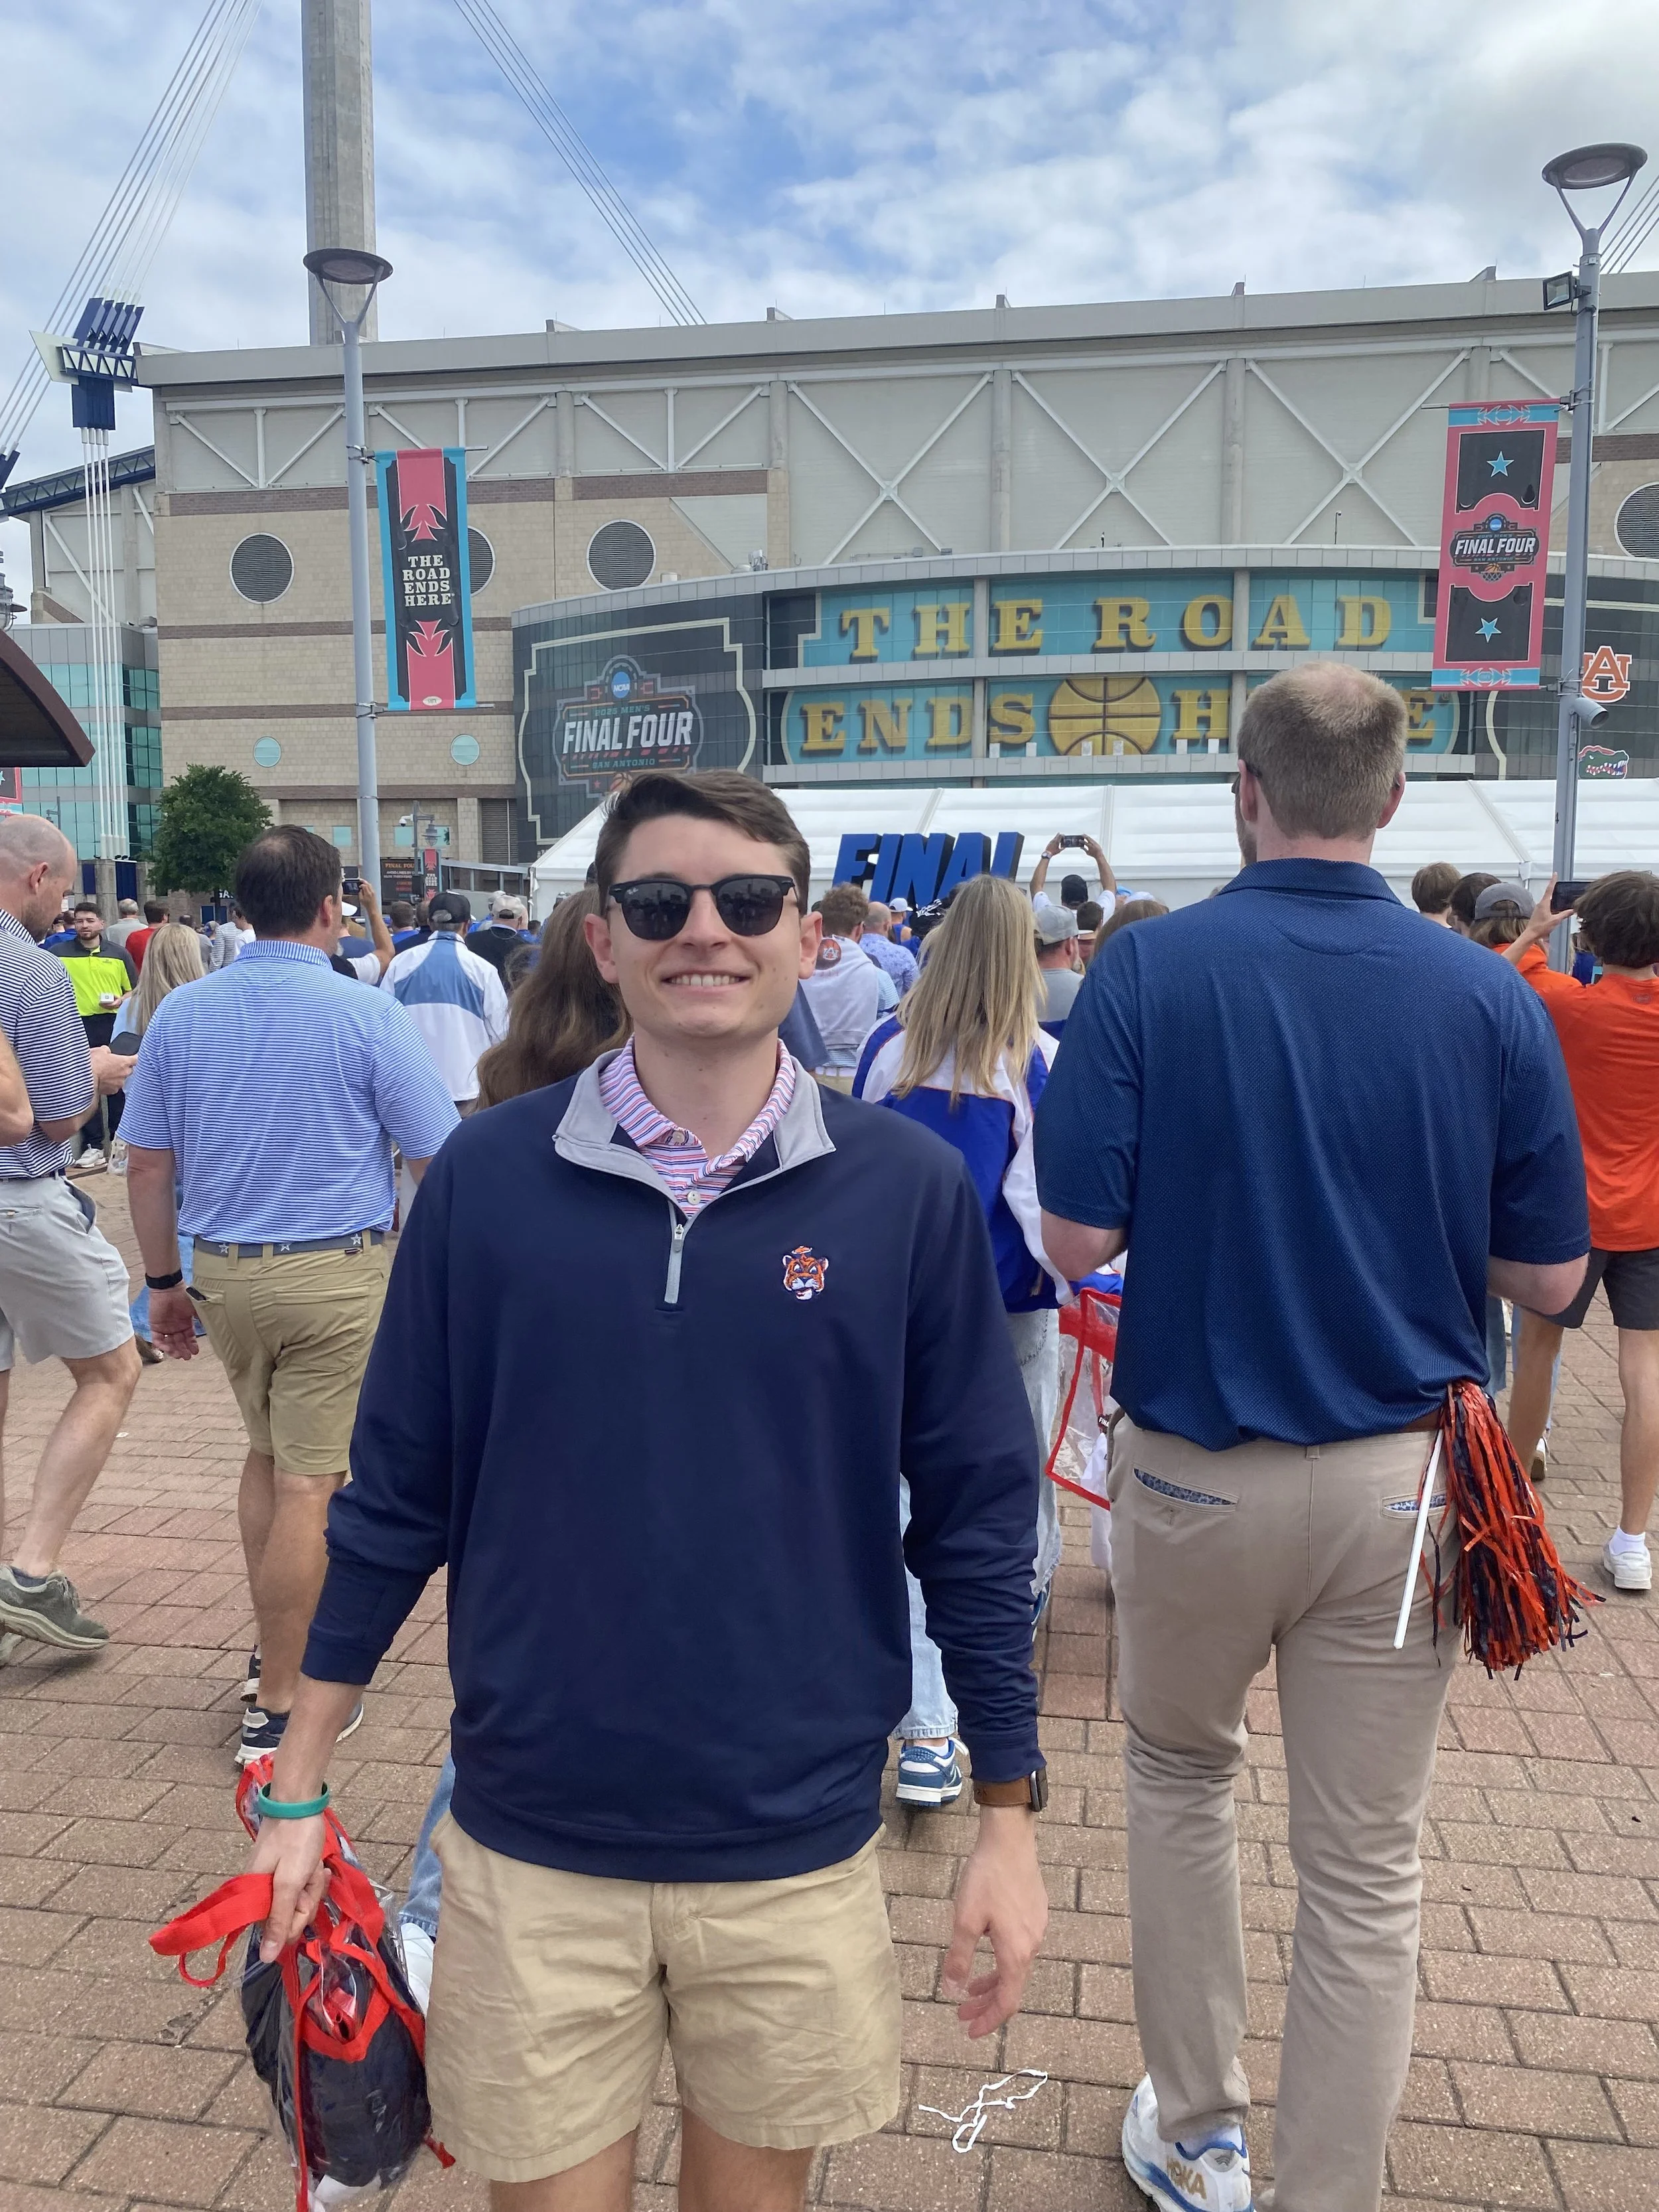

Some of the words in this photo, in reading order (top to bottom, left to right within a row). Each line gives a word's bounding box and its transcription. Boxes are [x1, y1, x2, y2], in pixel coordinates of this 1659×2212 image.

[1455, 539, 1494, 555] FINAL
[1496, 537, 1536, 553] FOUR
[407, 555, 443, 567] THE
[402, 567, 451, 581] ROAD
[403, 580, 450, 594] ENDS
[840, 598, 1043, 658] THE
[1092, 594, 1392, 650] ROAD
[595, 706, 617, 716] 2025
[620, 704, 650, 714] MEN'S
[802, 692, 1036, 751] ENDS
[1173, 688, 1436, 740] HE
[562, 717, 623, 754] FINAL
[626, 711, 693, 749] FOUR
[612, 758, 656, 767] ANTONIO
[1098, 1416, 1110, 1428] FINA
